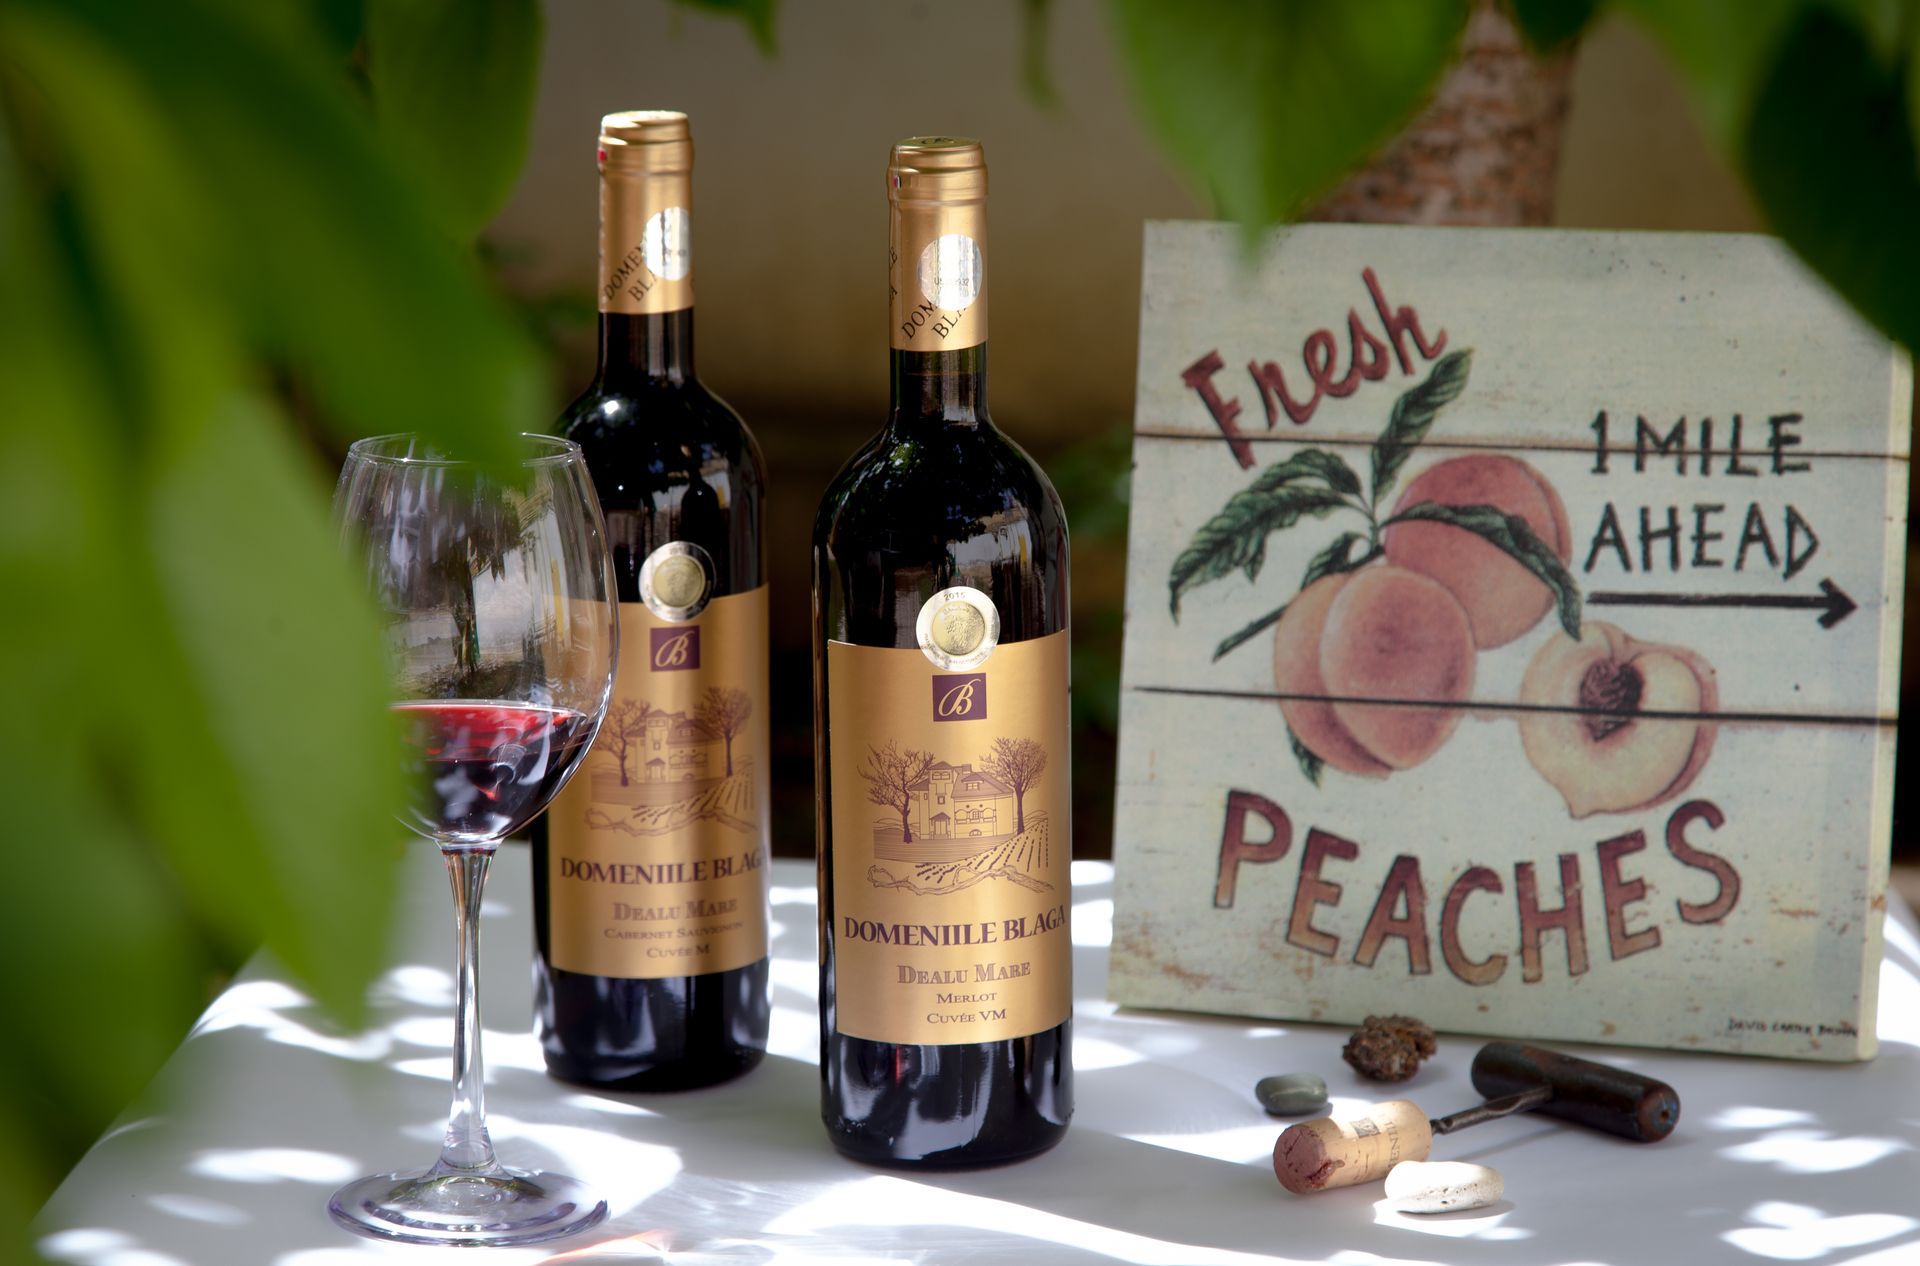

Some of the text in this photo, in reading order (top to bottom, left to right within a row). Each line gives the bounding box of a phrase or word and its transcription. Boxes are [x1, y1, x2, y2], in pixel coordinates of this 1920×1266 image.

[1180, 266, 1448, 470] Fresh
[1589, 410, 1812, 475] 1 MILE
[1584, 502, 1821, 581] AHEAD
[655, 630, 695, 668] B
[938, 678, 982, 717] B
[561, 846, 765, 885] DOMENIILE BLAG
[1212, 790, 1742, 986] PEACHES
[613, 899, 738, 921] DEALU MARE
[844, 904, 1067, 947] DOMENIILE BLAGA
[604, 921, 744, 940] CABERNET SAUVIGNON
[695, 943, 711, 956] M
[897, 962, 1031, 985] DEALU MARE
[926, 1008, 1008, 1024] CUVÉE VM
[936, 992, 998, 1004] MERLOT
